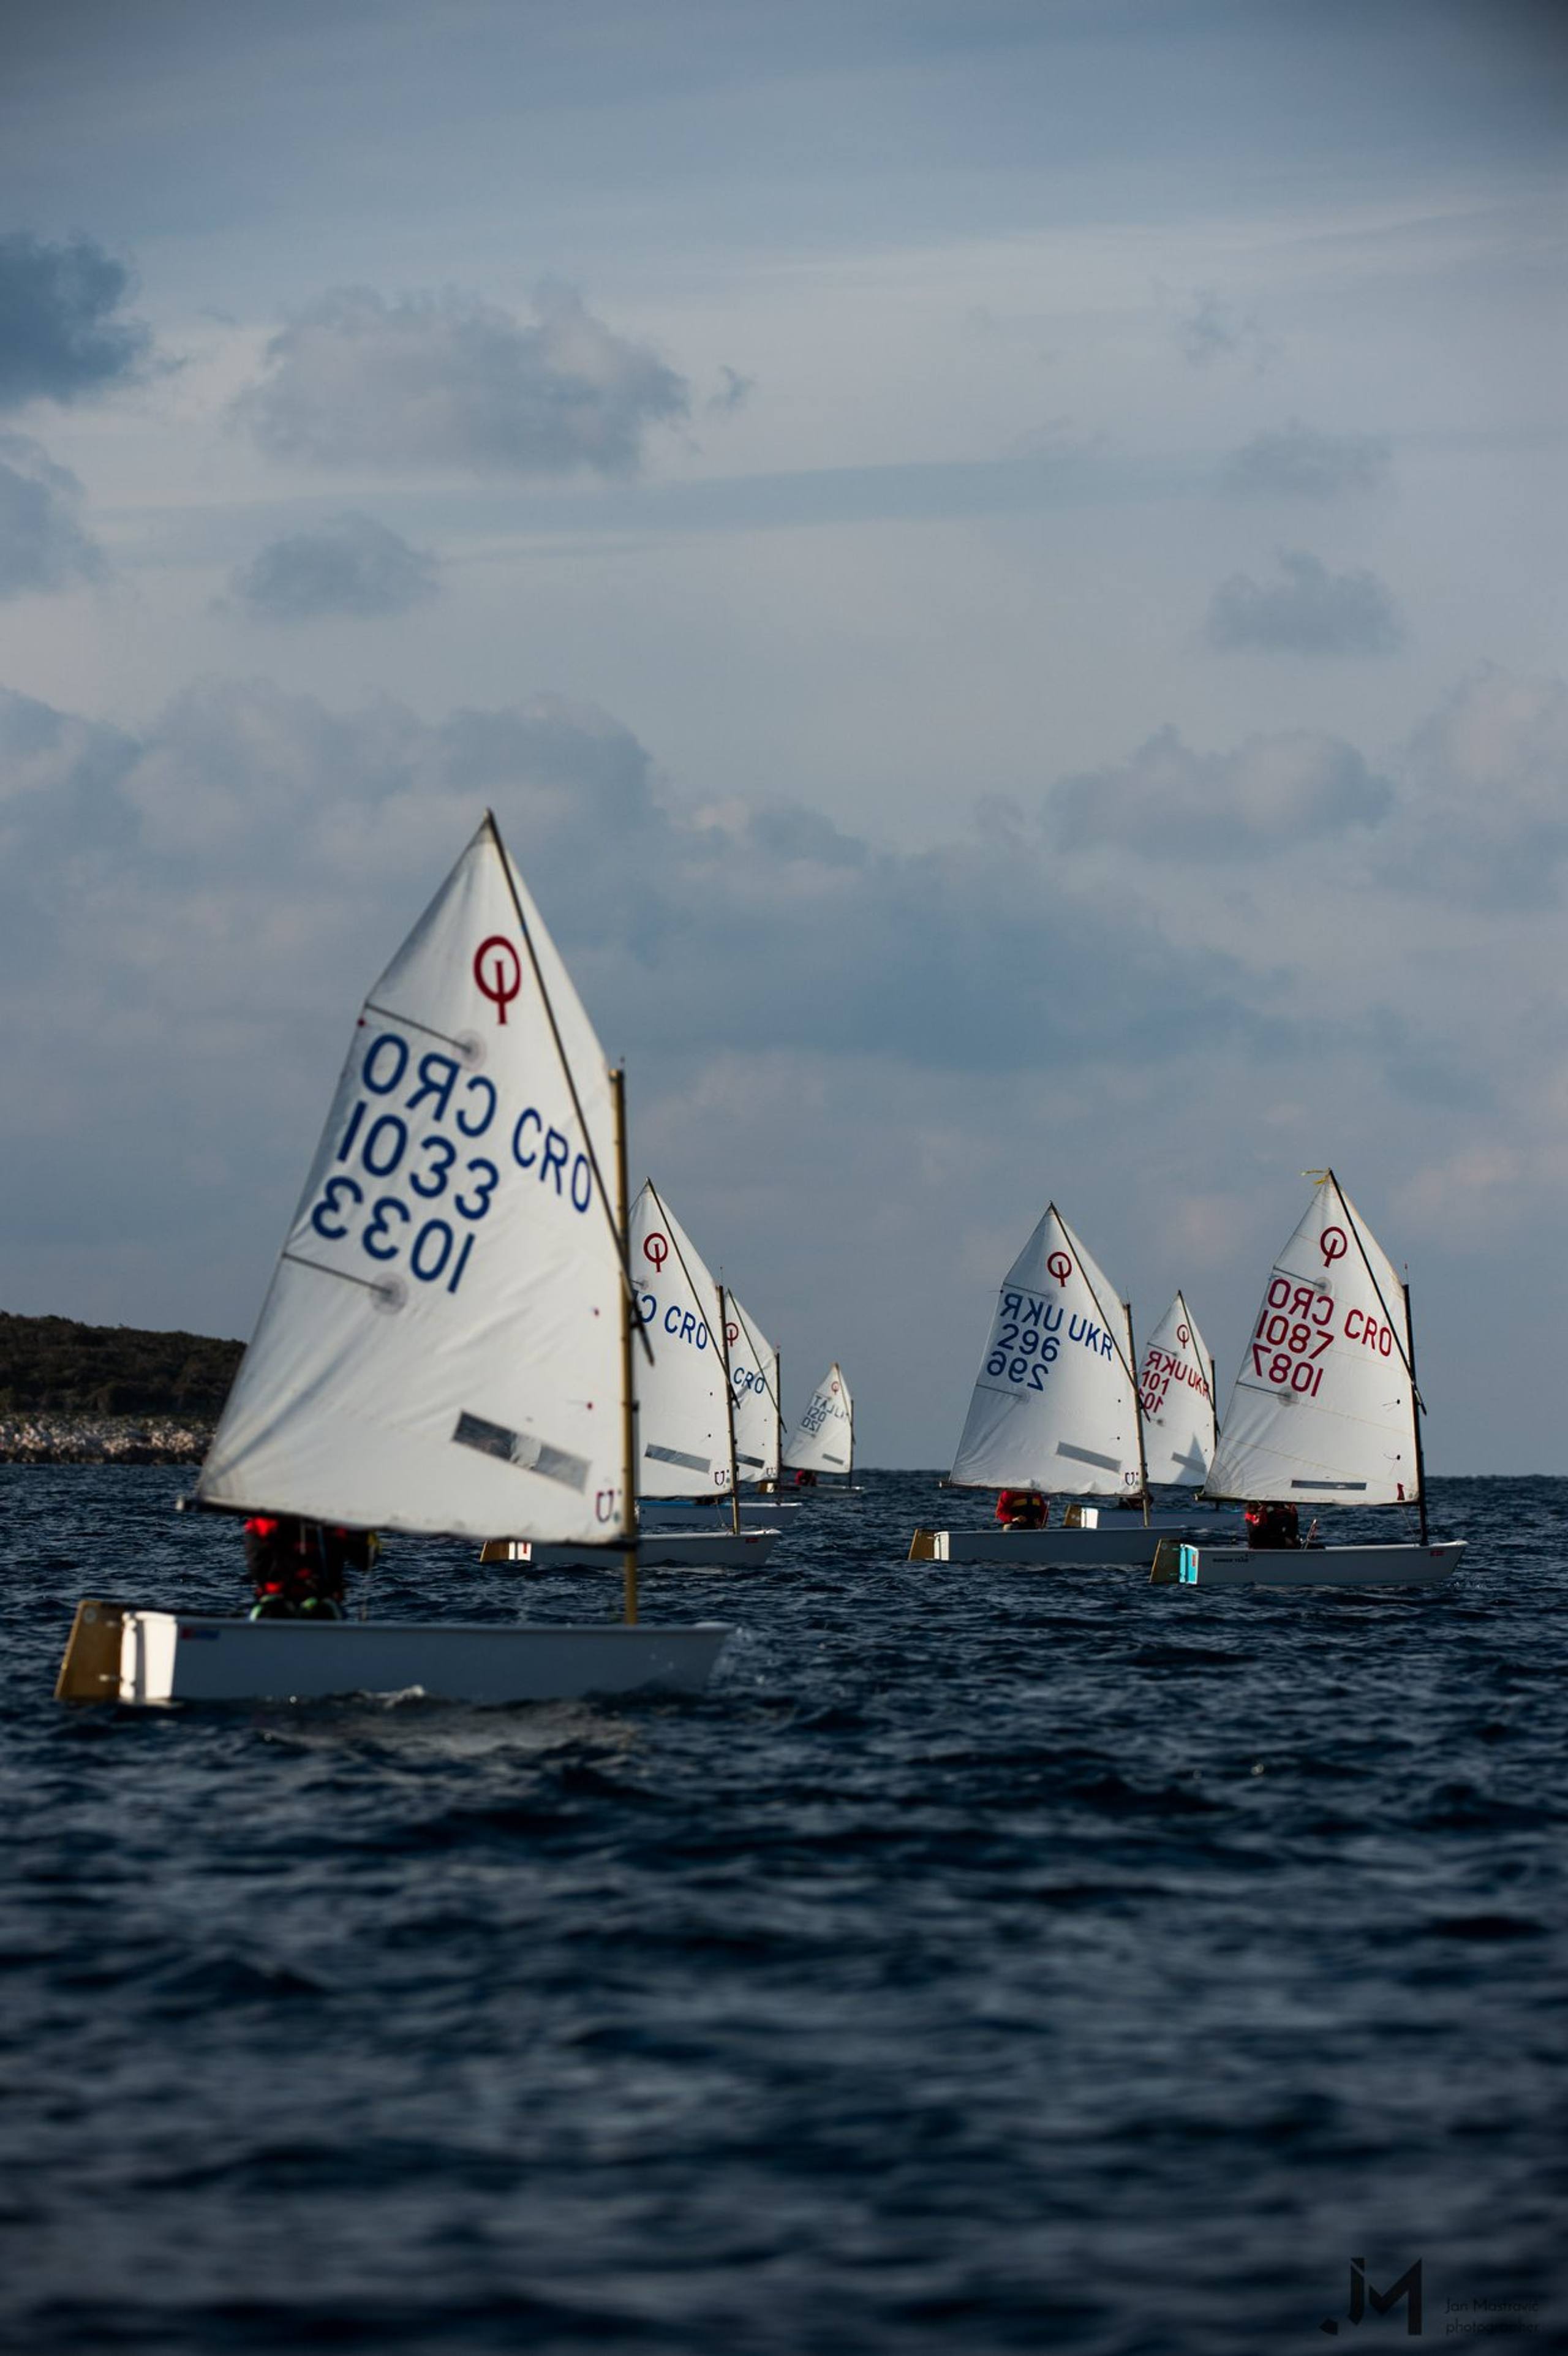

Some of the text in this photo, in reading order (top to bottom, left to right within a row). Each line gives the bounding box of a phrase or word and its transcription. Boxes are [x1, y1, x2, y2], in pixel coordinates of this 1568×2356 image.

[337, 1101, 499, 1220] 1033
[512, 1108, 591, 1213] CRO
[665, 1305, 707, 1350] CRO
[997, 1323, 1060, 1362] 296
[1069, 1314, 1113, 1361] UKR
[1256, 1310, 1335, 1359] 1087
[1344, 1309, 1392, 1357] CRO
[733, 1367, 765, 1394] CRO
[1142, 1370, 1170, 1395] 101
[807, 1406, 827, 1422] 120
